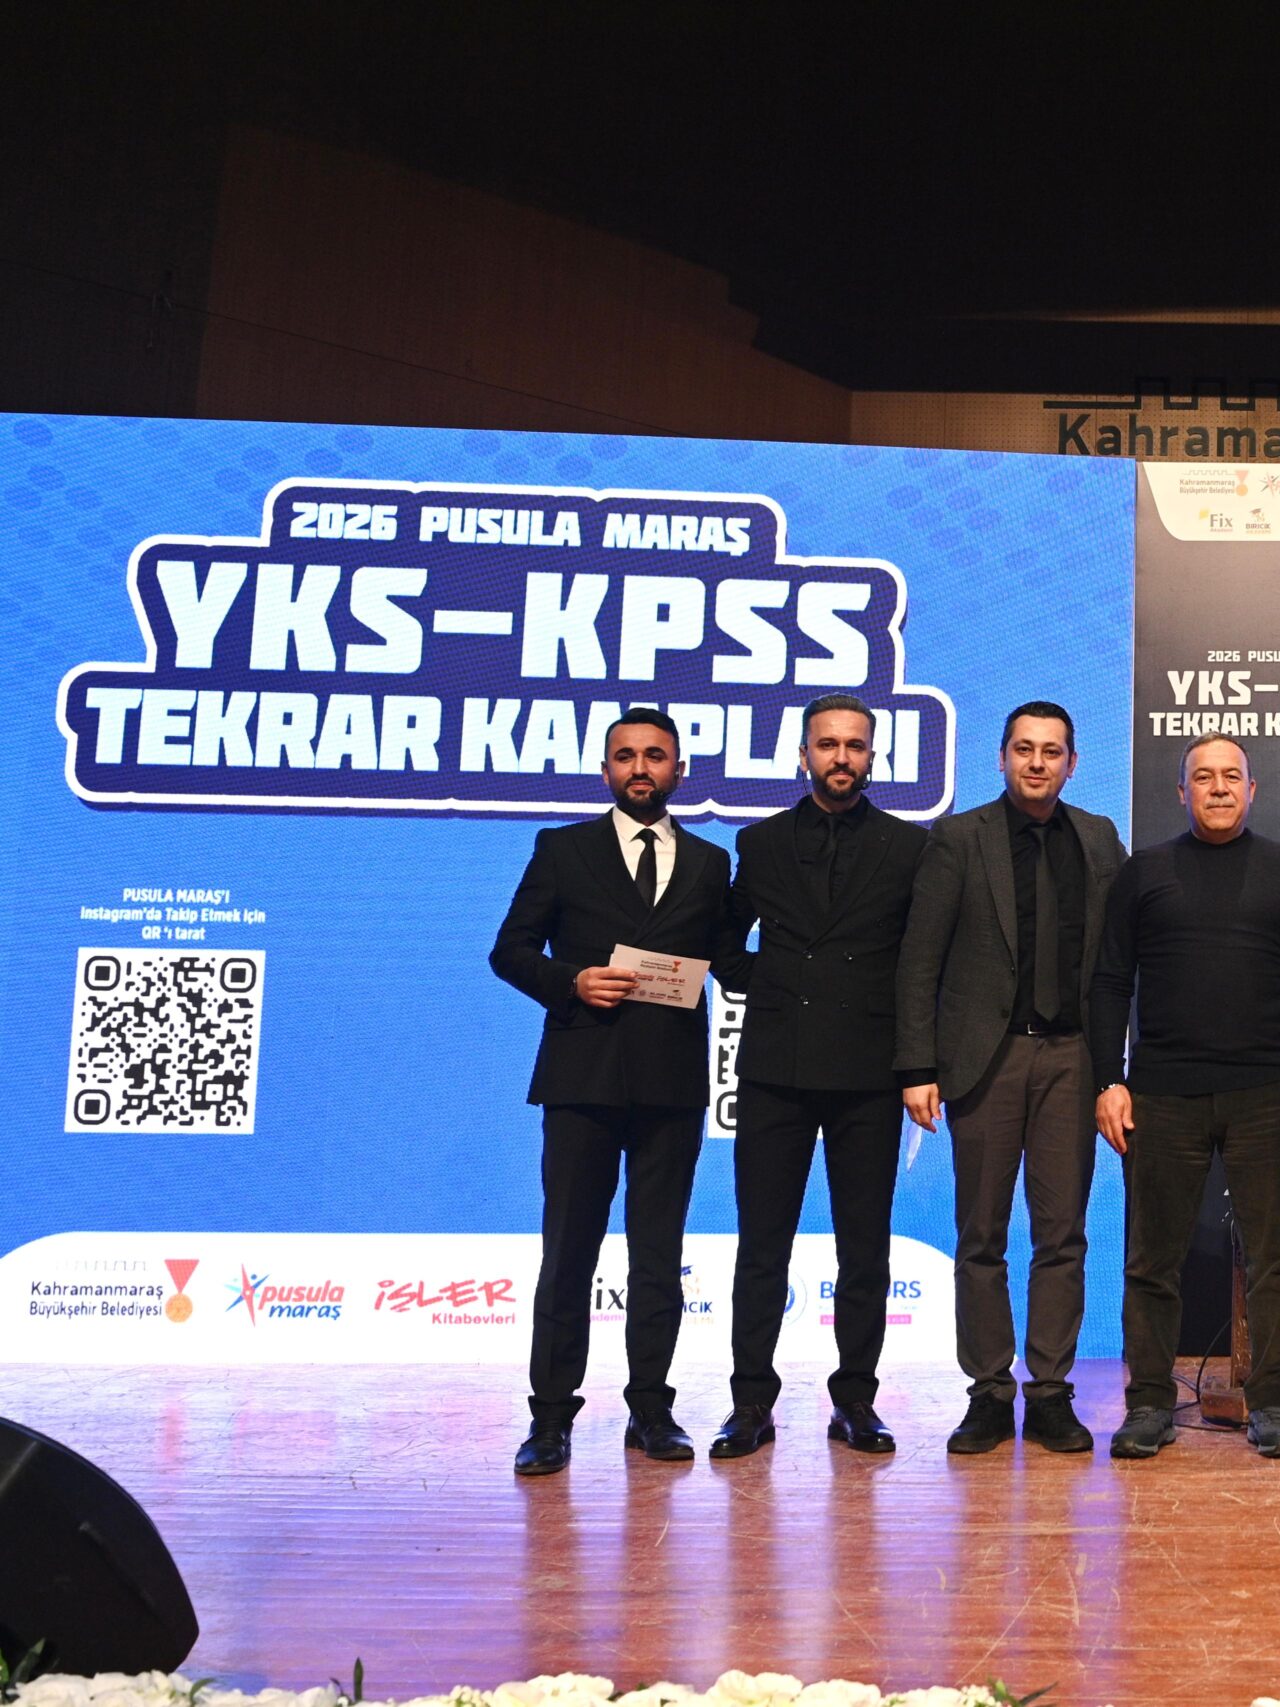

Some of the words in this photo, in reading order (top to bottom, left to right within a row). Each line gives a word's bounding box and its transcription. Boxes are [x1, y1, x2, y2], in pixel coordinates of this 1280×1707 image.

[291, 502, 397, 542] 2026
[420, 507, 582, 547] PUSULA
[603, 512, 751, 557] MARAŞ
[1210, 513, 1233, 528] Fix
[1207, 651, 1241, 662] 2026
[85, 687, 443, 773] TEKRAR
[1149, 712, 1259, 737] TEKRAR
[123, 888, 174, 902] PUSULA
[165, 907, 198, 923] Takip
[201, 908, 241, 922] Etmek
[141, 926, 161, 940] QR
[175, 926, 206, 940] tarat
[31, 1281, 164, 1300] Kahramanmaraş
[258, 1279, 346, 1310] pusula
[596, 1277, 625, 1310] ix
[887, 1281, 921, 1299] RS
[29, 1301, 97, 1319] Büyükşehir
[101, 1301, 162, 1319] Belediyesi
[269, 1303, 342, 1321] maraş
[431, 1312, 517, 1325] Kitabevleri
